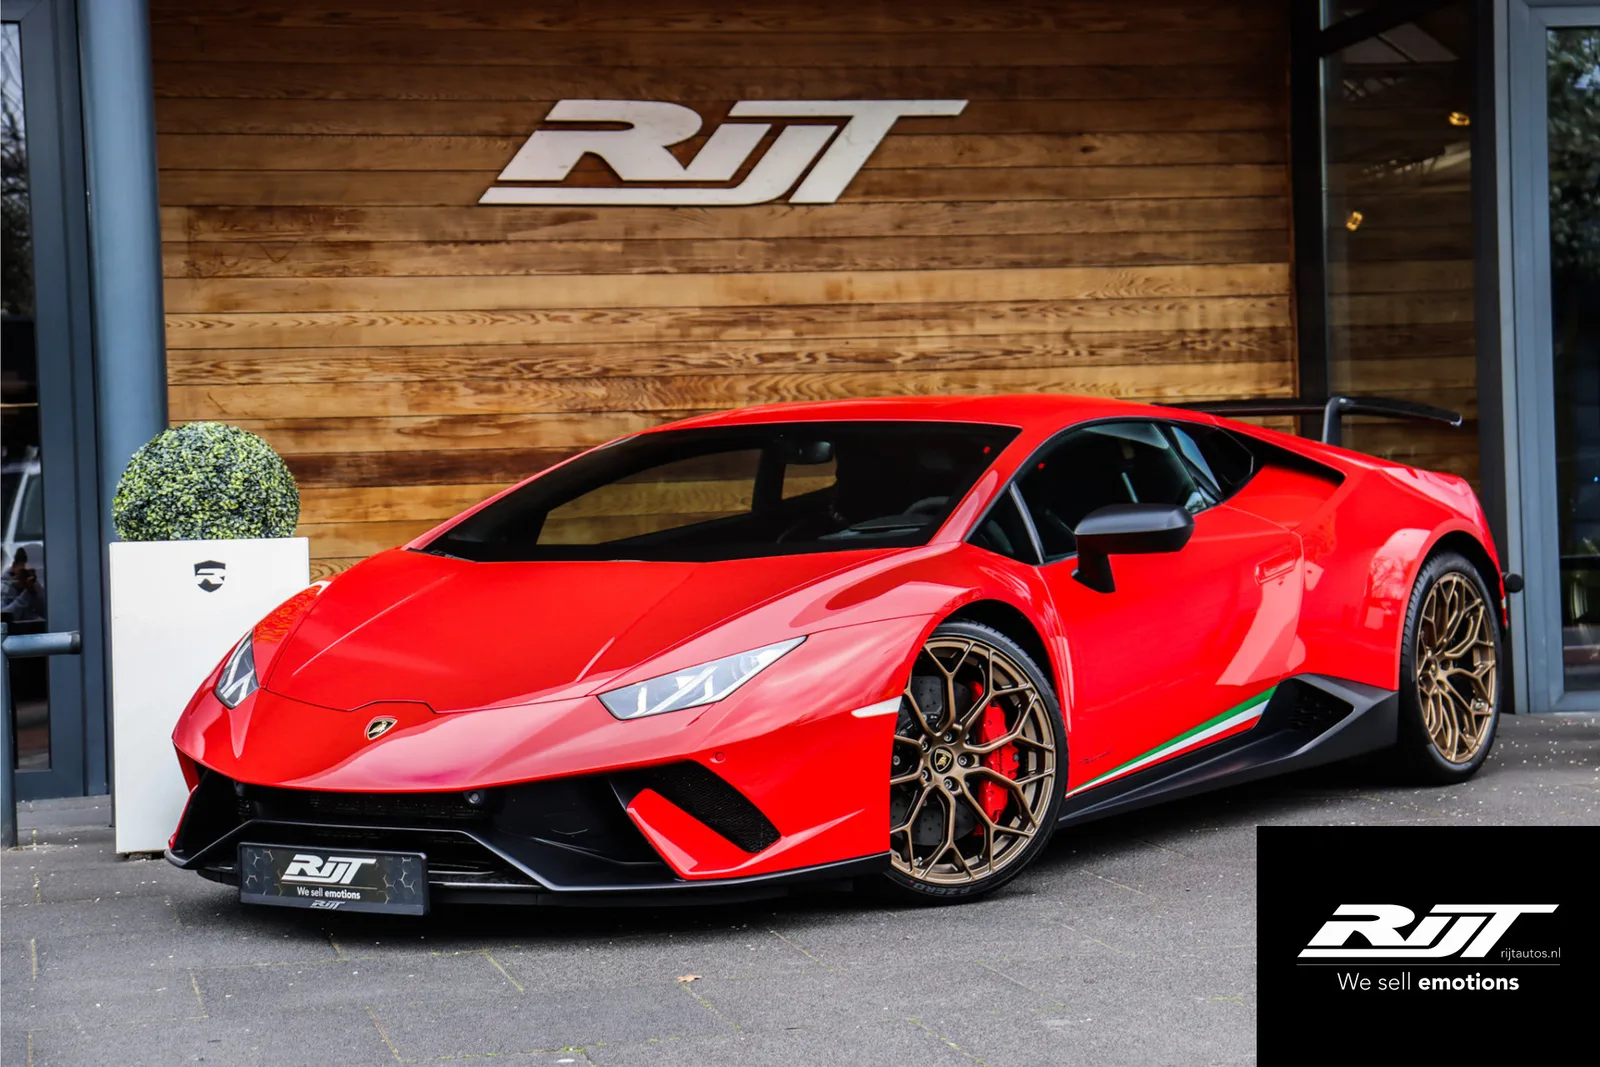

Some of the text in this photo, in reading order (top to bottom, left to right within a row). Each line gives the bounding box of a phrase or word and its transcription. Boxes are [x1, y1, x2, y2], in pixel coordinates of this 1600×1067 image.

[296, 886, 361, 900] We sell emotions
[913, 883, 958, 895] ZERO
